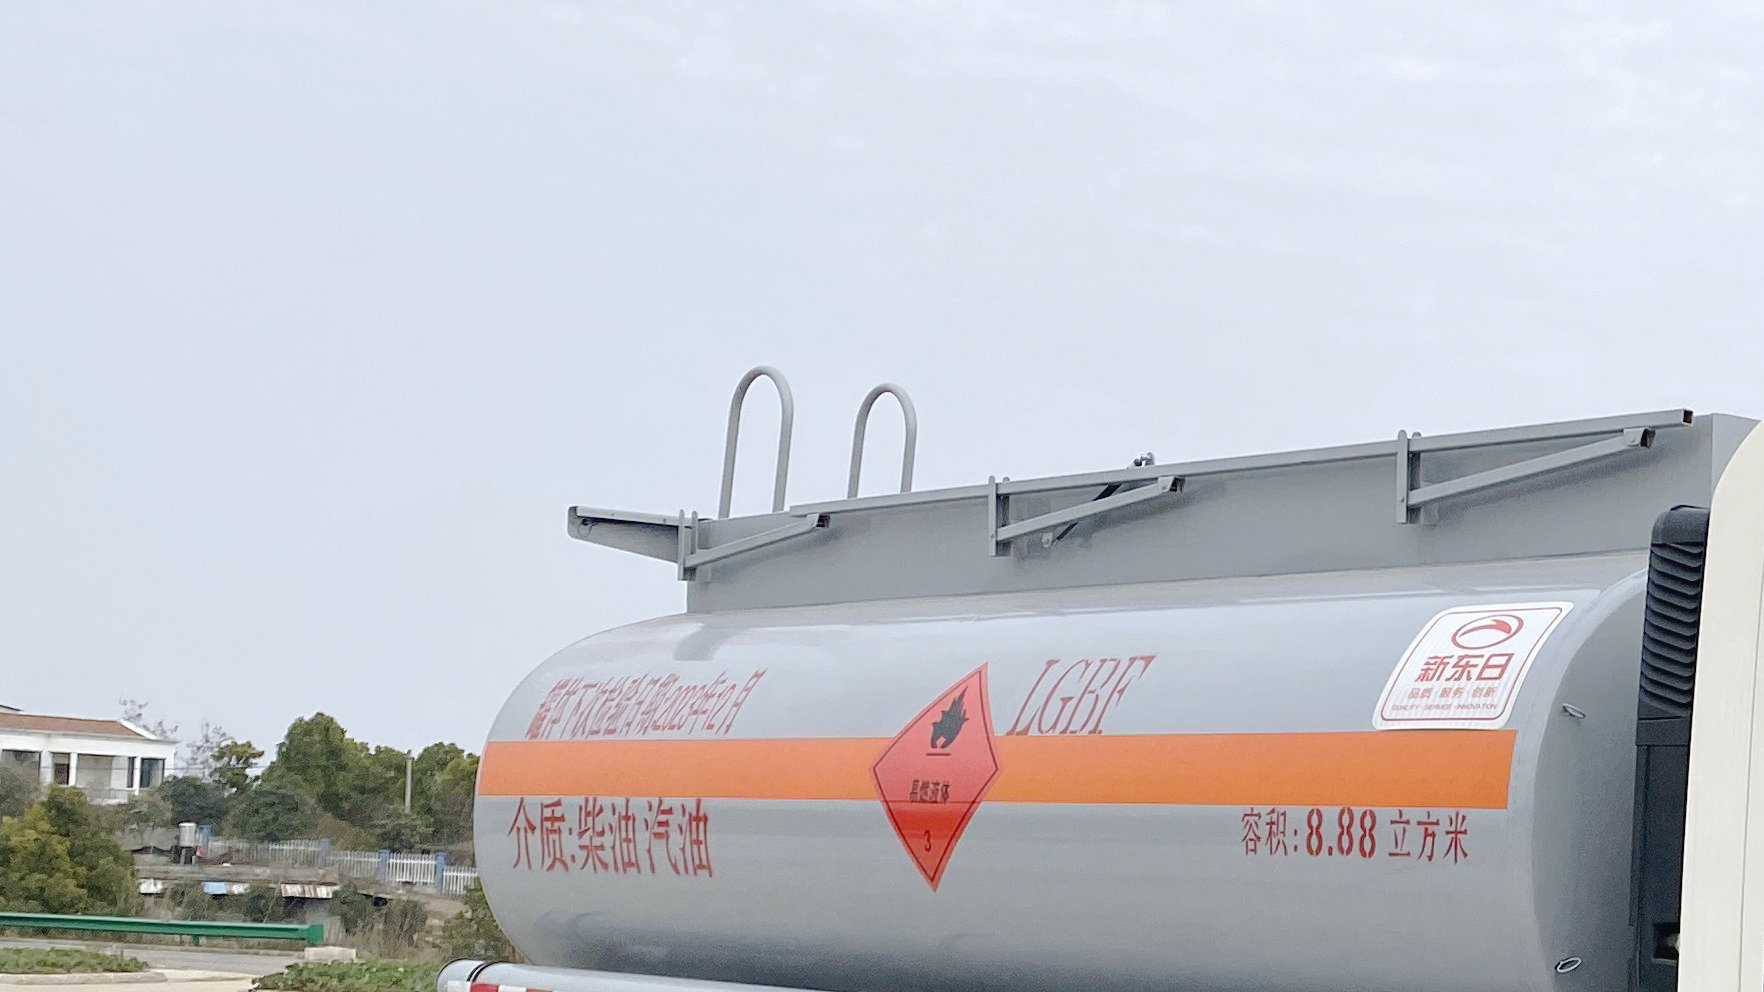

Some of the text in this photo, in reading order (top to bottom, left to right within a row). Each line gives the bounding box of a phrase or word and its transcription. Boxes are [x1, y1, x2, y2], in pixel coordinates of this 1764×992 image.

[1415, 653, 1514, 682] 新东日
[924, 829, 931, 853] 3
